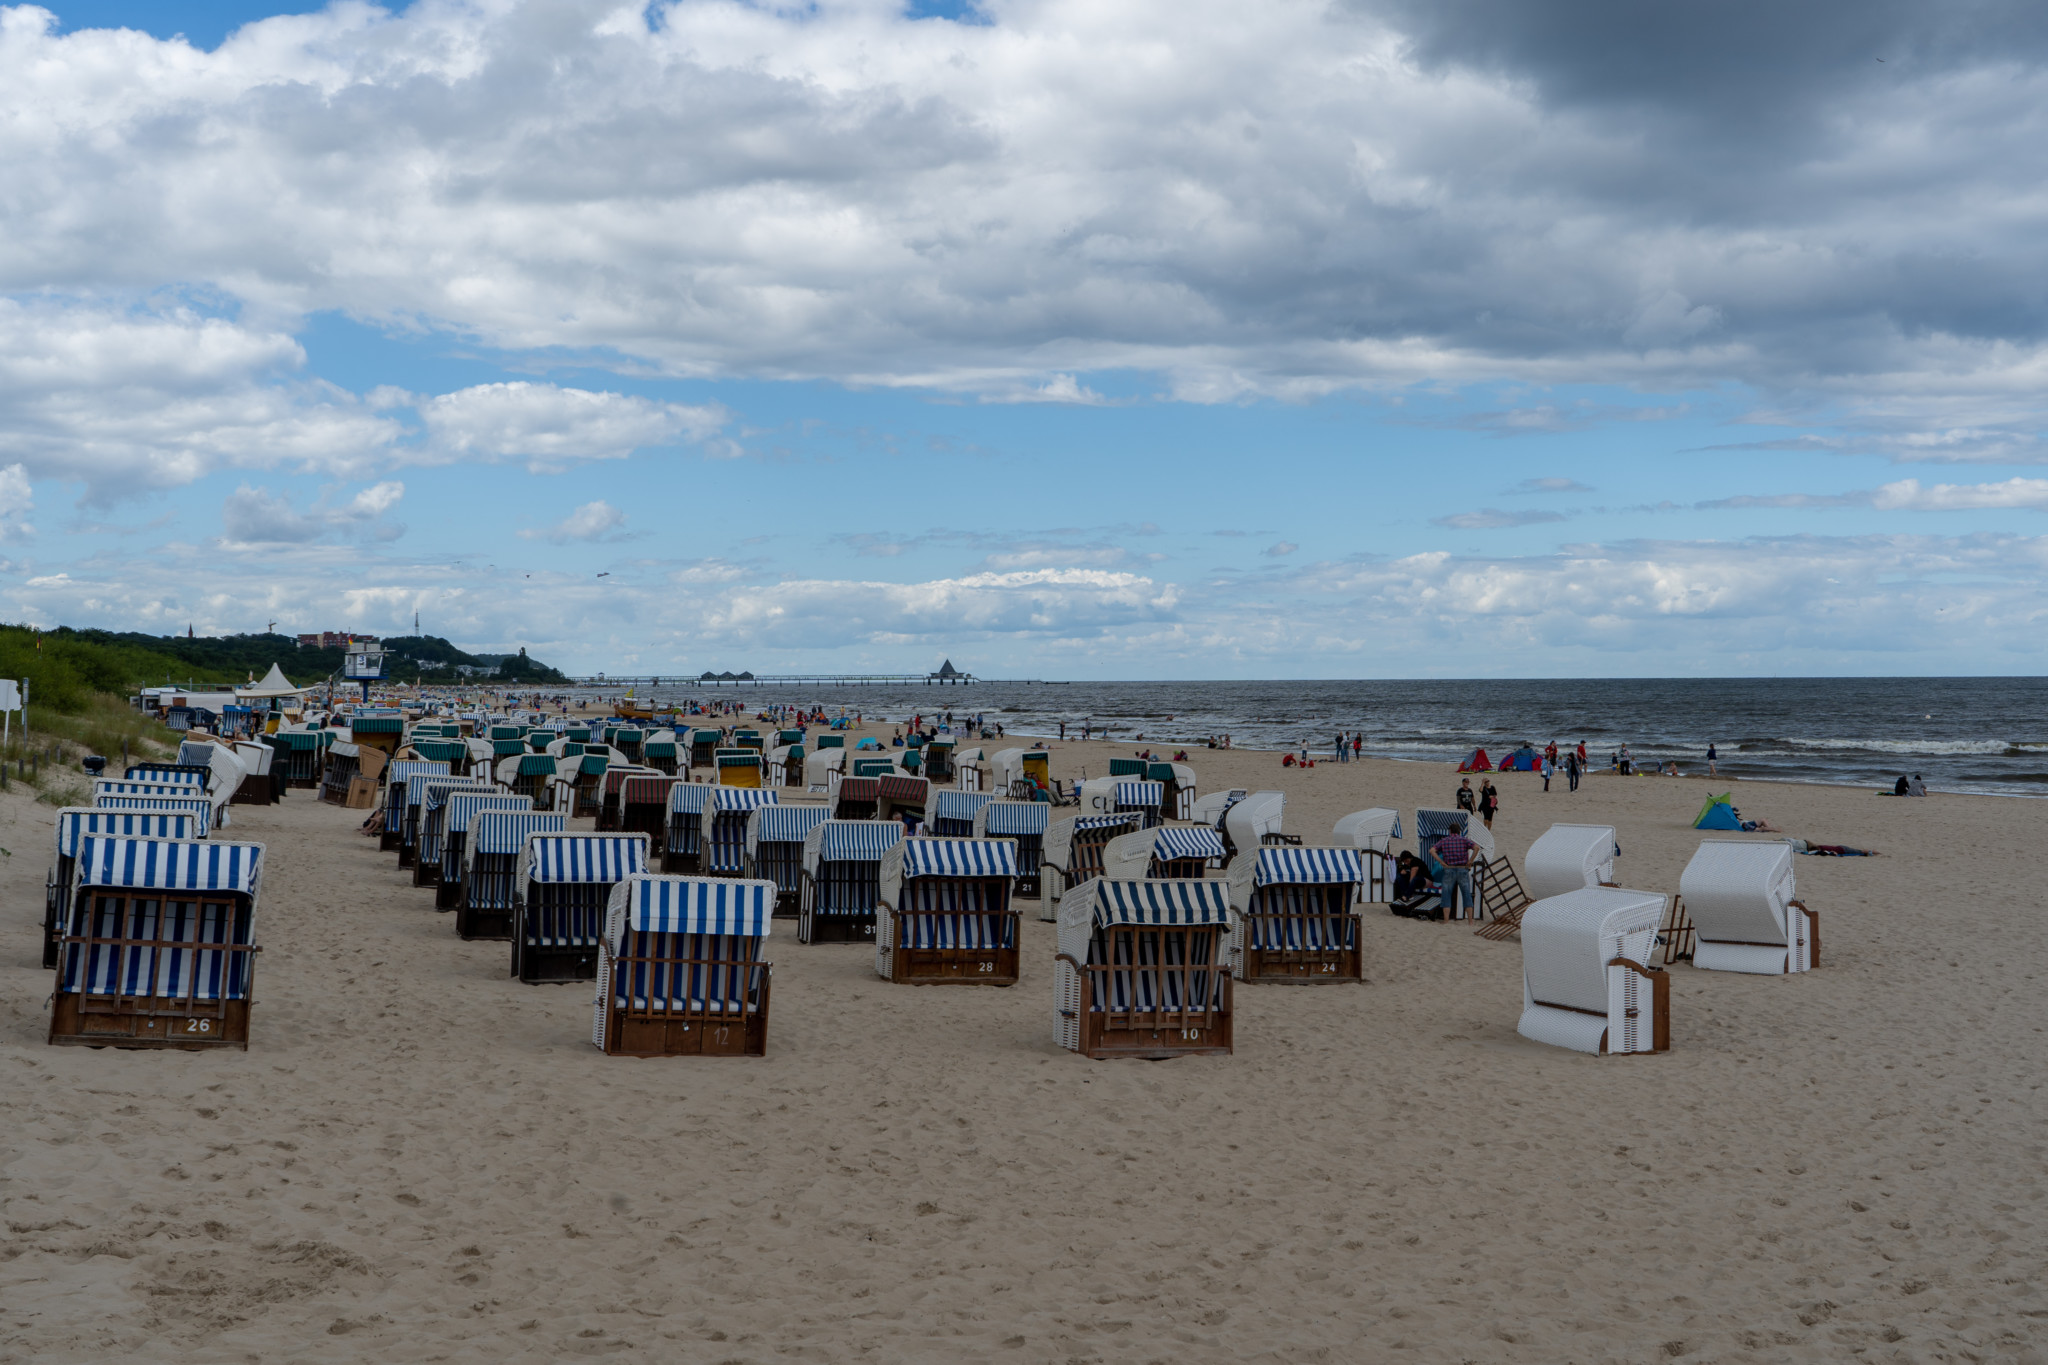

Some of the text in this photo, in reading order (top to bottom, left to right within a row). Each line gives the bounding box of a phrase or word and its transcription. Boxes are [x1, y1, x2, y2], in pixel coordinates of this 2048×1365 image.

[1022, 883, 1032, 892] 21
[864, 924, 876, 935] 31
[978, 961, 993, 972] 28
[1322, 962, 1336, 973] 24
[187, 1018, 211, 1032] 26
[713, 1027, 729, 1046] 12
[1180, 1028, 1198, 1040] 10
